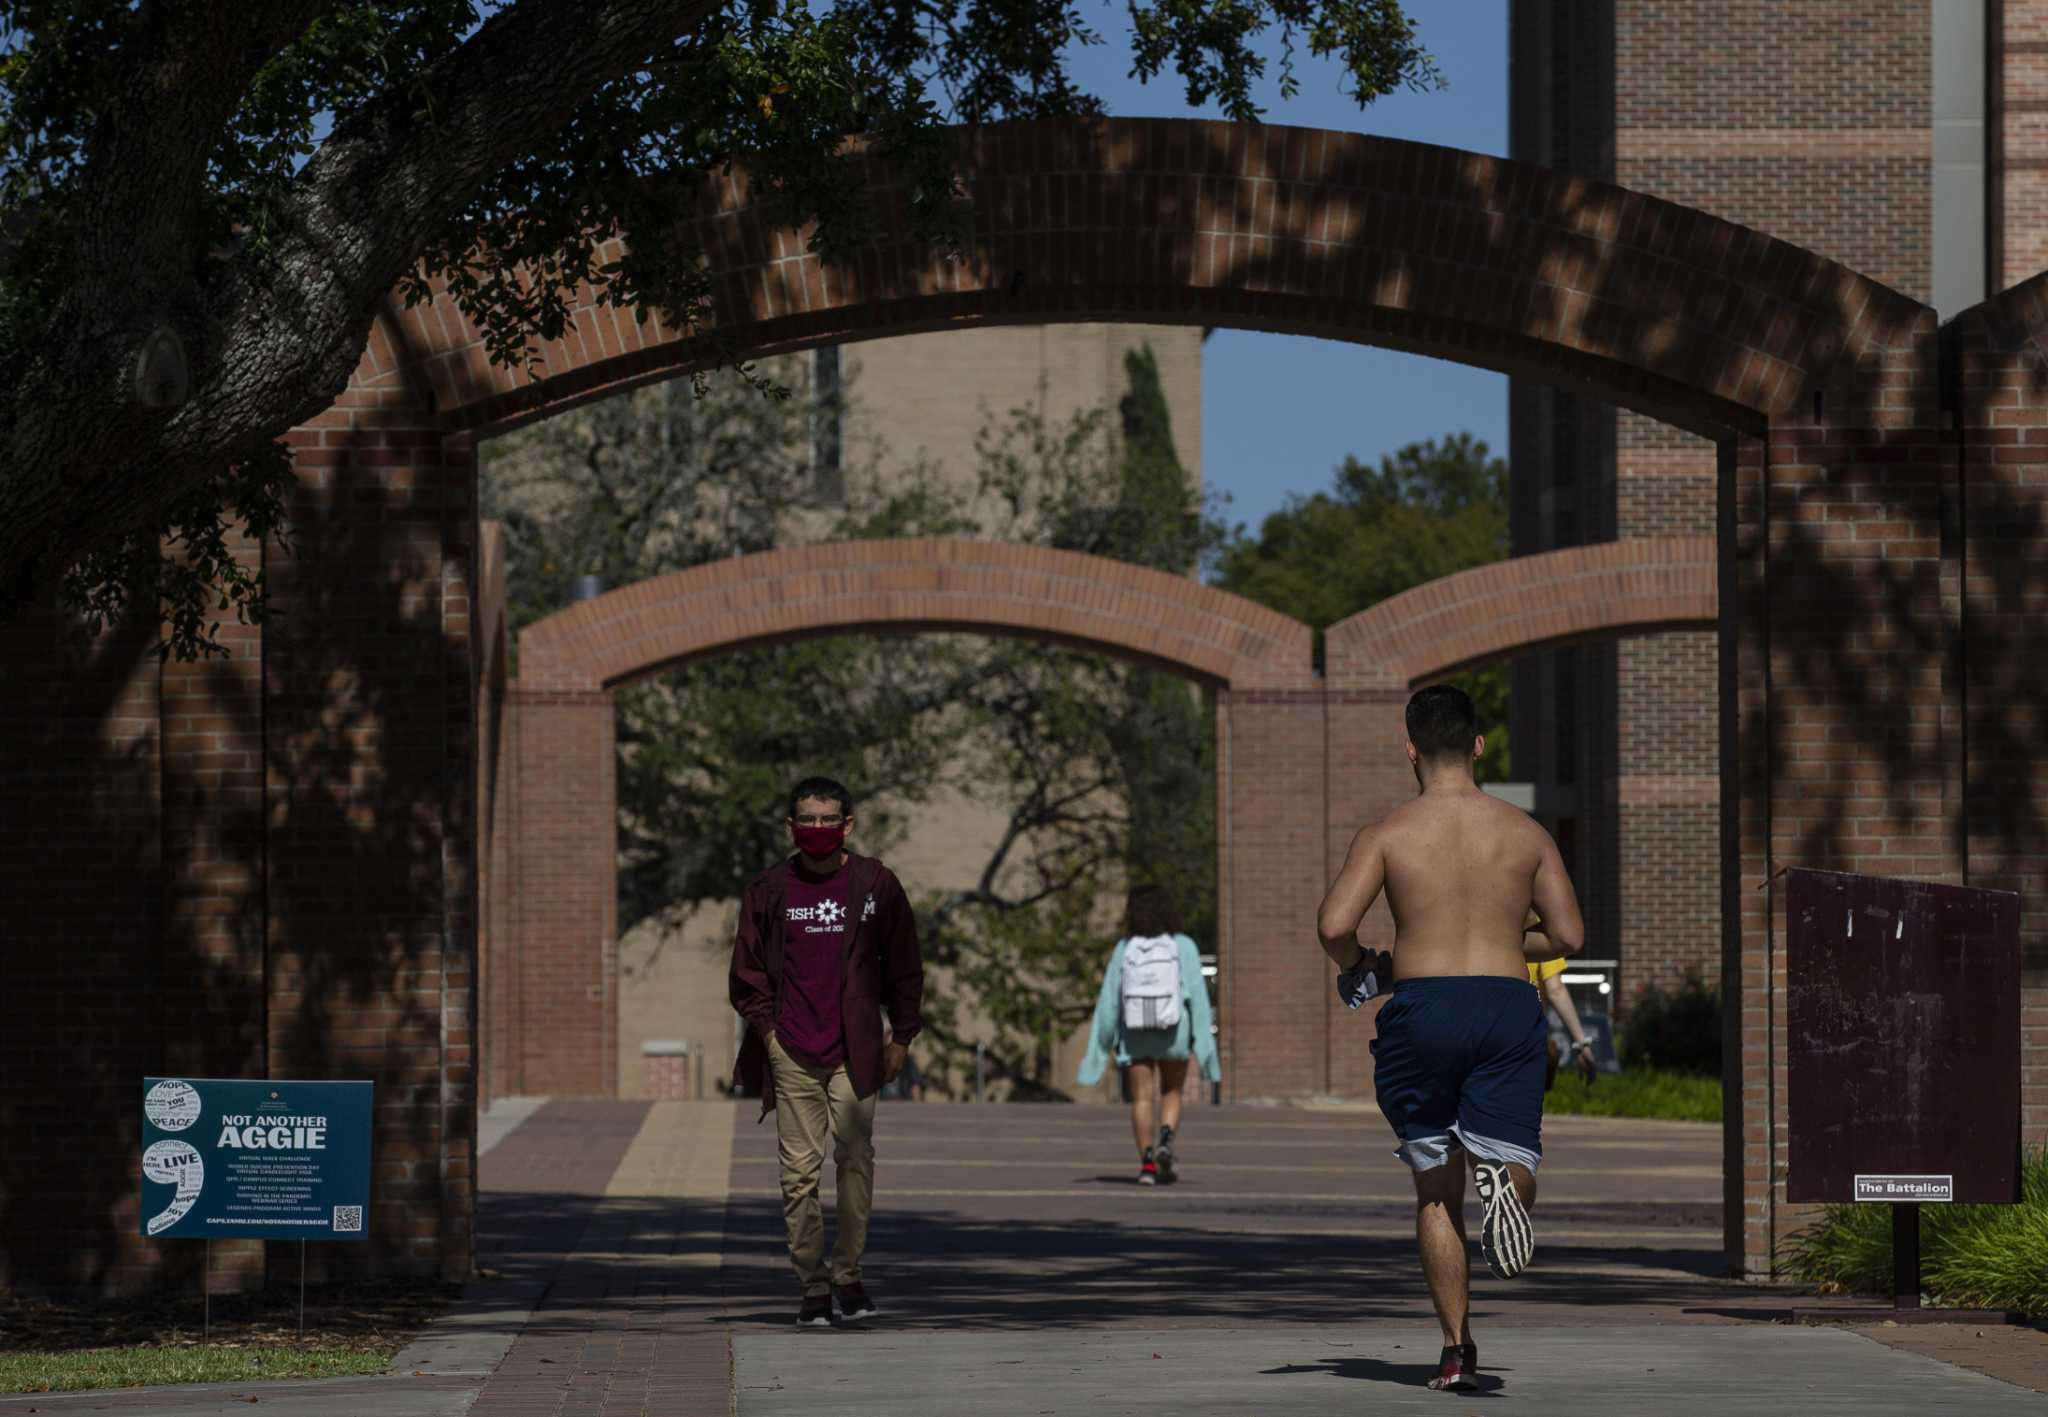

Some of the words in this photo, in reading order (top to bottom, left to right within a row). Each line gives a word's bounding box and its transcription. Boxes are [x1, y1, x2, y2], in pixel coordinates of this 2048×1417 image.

[166, 1096, 184, 1106] YOU
[222, 1114, 252, 1126] NOT
[256, 1116, 327, 1127] ANOTHER
[217, 1126, 326, 1149] AGGIE
[164, 1152, 199, 1169] LIVE
[1859, 1183, 1882, 1193] The
[1886, 1183, 1948, 1193] Battalion
